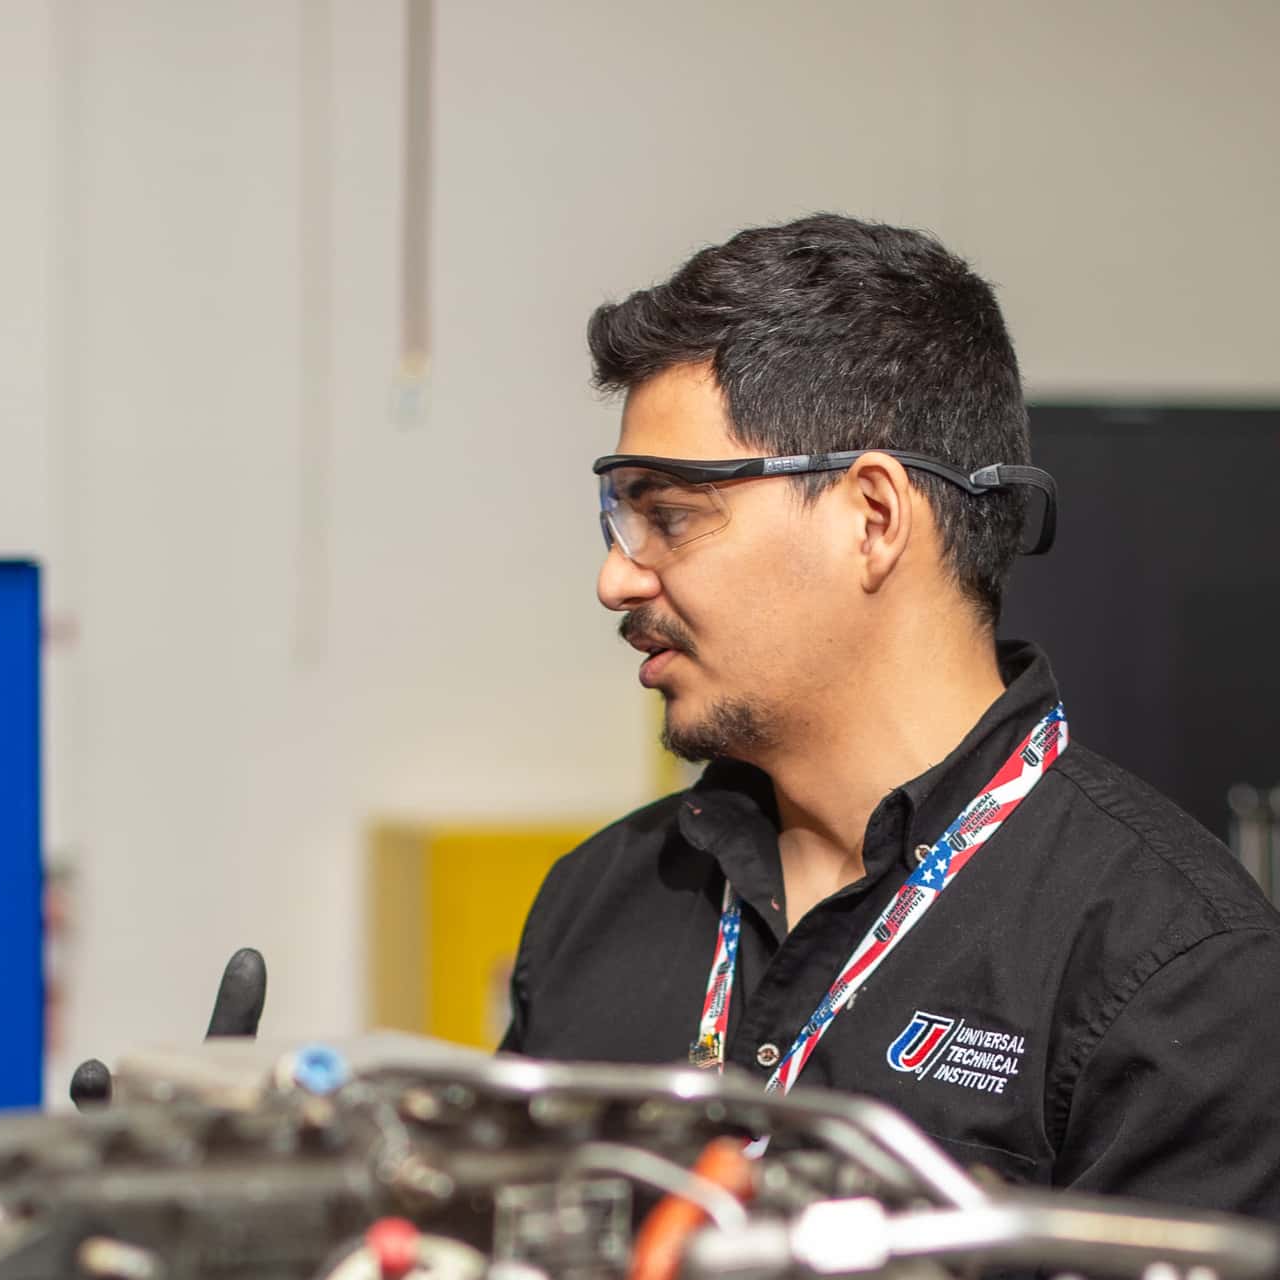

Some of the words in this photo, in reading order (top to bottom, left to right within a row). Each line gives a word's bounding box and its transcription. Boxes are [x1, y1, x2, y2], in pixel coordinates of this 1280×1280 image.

[956, 1026, 1025, 1053] UNIVERSAL
[946, 1045, 1019, 1074] TECHNICAL
[933, 1064, 1008, 1093] INSTITUTE
